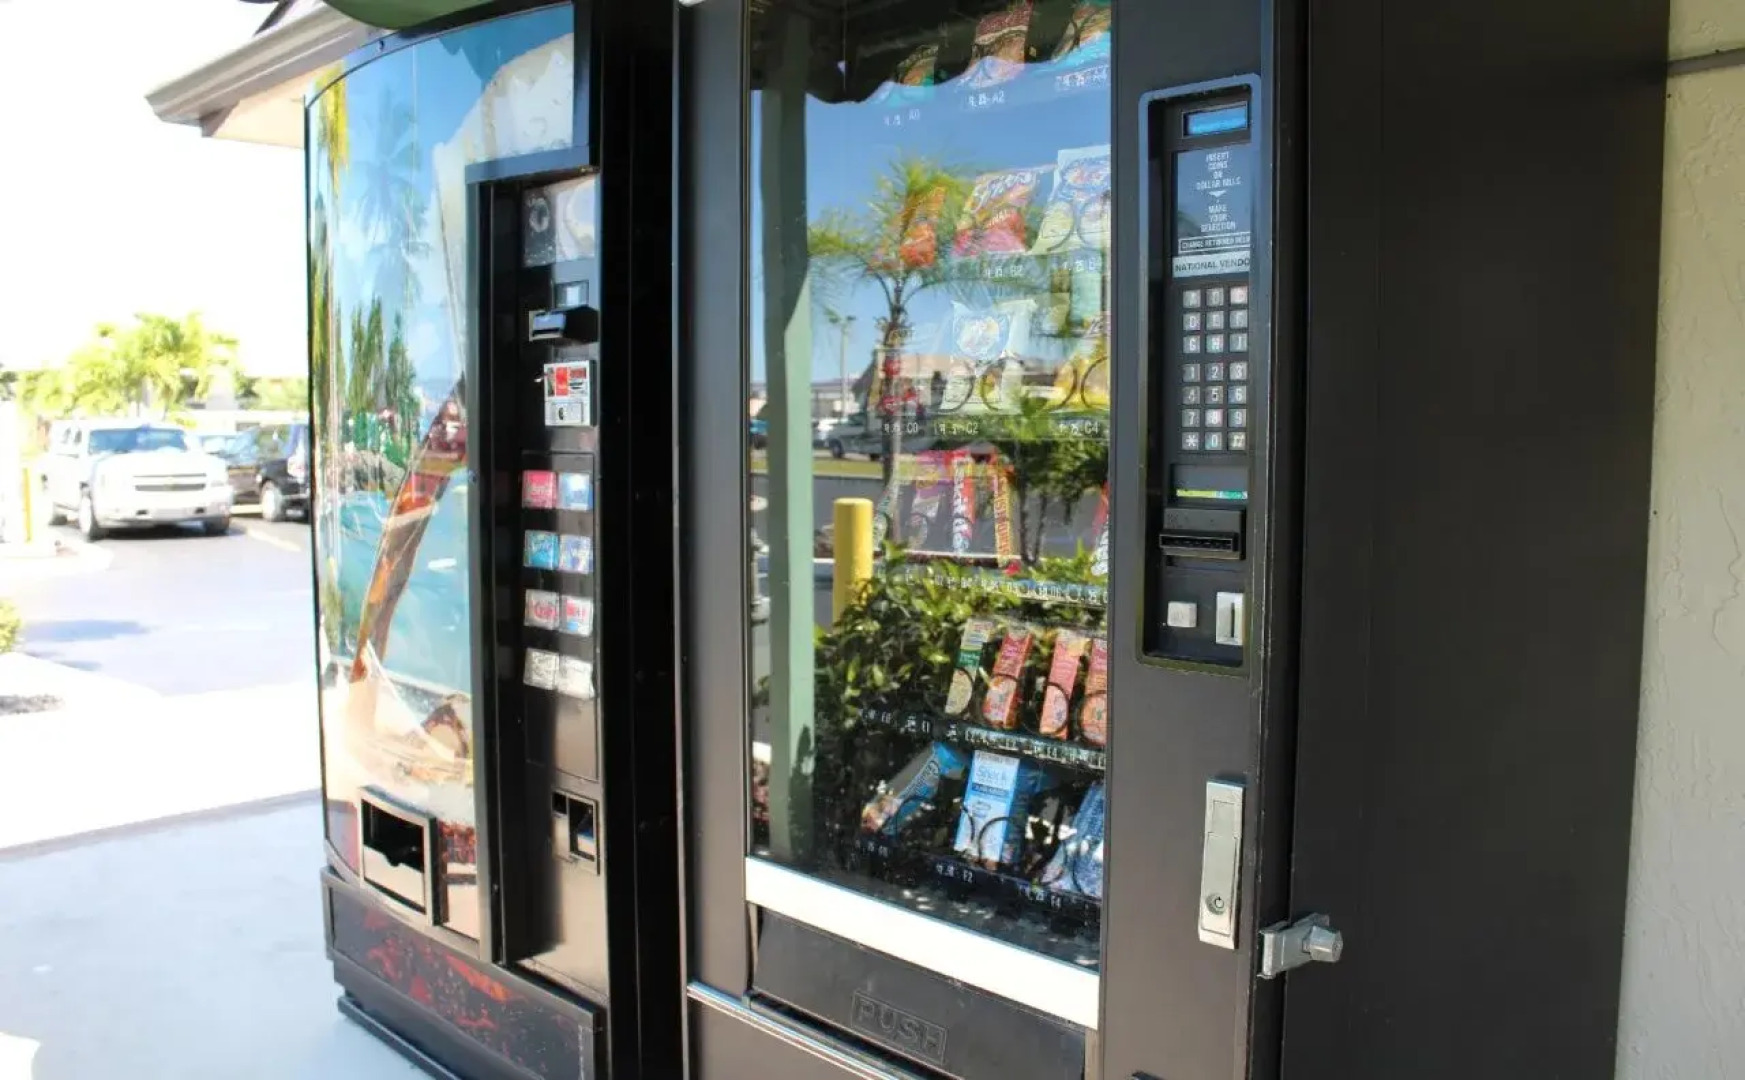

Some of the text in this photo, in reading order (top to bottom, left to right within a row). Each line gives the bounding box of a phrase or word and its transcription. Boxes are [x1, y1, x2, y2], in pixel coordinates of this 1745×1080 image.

[1206, 151, 1229, 162] INSERT
[1208, 161, 1228, 170] COINS
[1212, 171, 1223, 180] OR
[1196, 176, 1242, 190] DOLLAR BILLS
[1208, 204, 1228, 214] MAKE
[1210, 213, 1228, 222] YOUR
[1200, 220, 1236, 232] SELECTION
[1175, 261, 1217, 272] NATIONAL
[1211, 366, 1218, 379] 2
[1236, 364, 1243, 377] 3
[1188, 388, 1243, 402] 4 5 6
[1188, 411, 1243, 425] 7 8 9
[1084, 421, 1098, 434] C4
[1211, 434, 1218, 447] 0
[962, 870, 974, 883] F2
[859, 999, 941, 1057] PUSH
